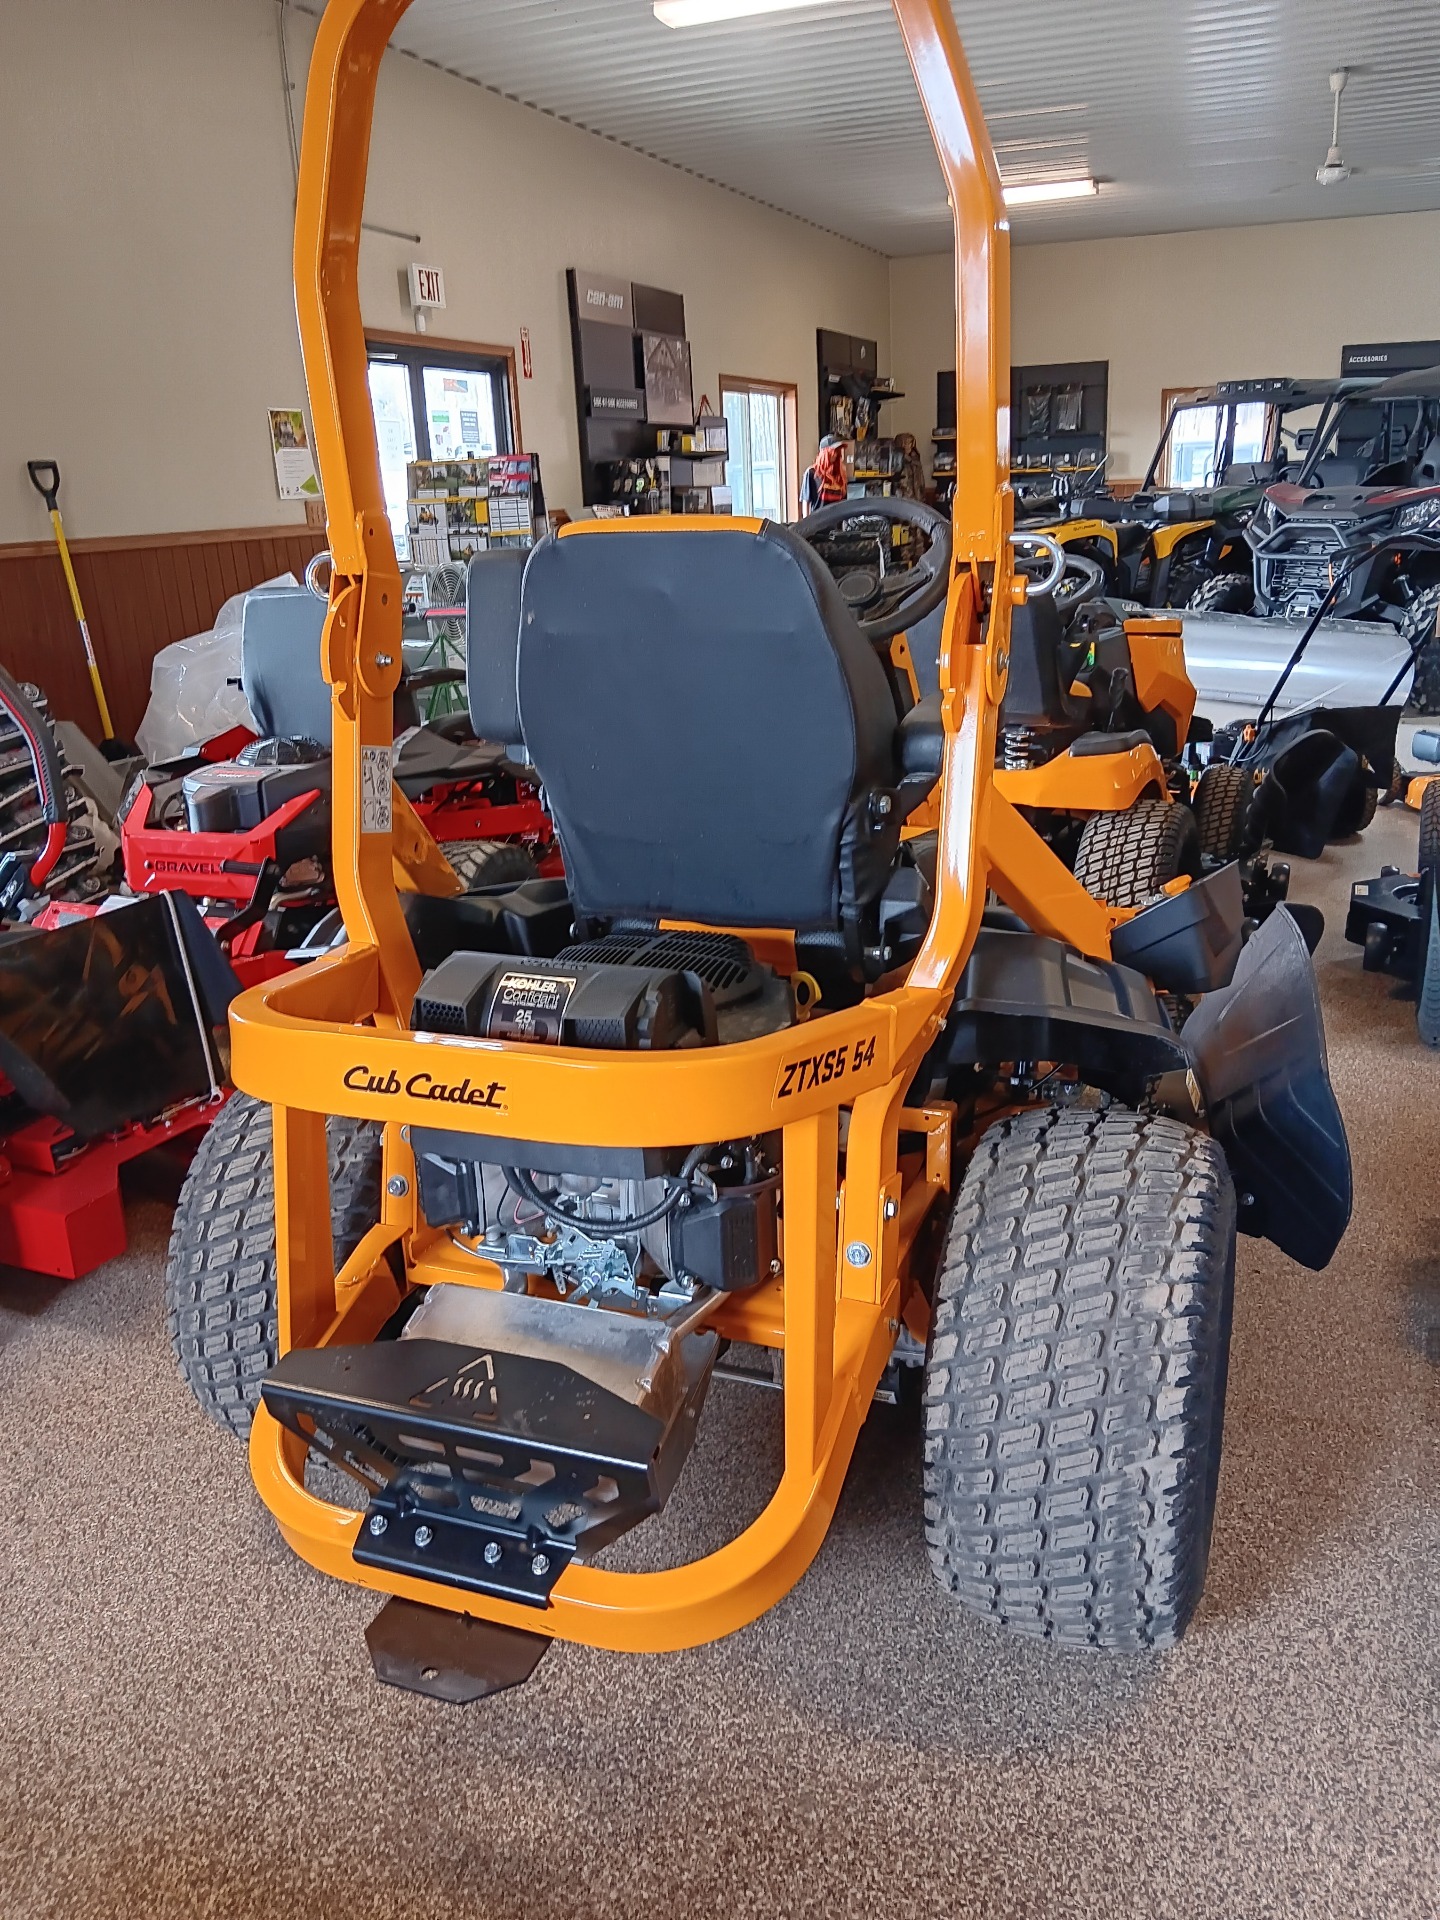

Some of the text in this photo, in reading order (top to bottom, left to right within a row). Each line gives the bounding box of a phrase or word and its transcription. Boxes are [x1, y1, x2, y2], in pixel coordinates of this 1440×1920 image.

[418, 269, 440, 302] EXIT
[587, 289, 624, 309] can-am
[1348, 354, 1388, 363] ACCESSORIES
[154, 860, 221, 875] GRAVEL
[507, 976, 557, 993] KOHLER
[503, 987, 560, 1003] Confidant
[515, 1009, 532, 1024] 25
[778, 1035, 876, 1098] ZTXS5 54
[343, 1065, 507, 1109] Cub Cadet
